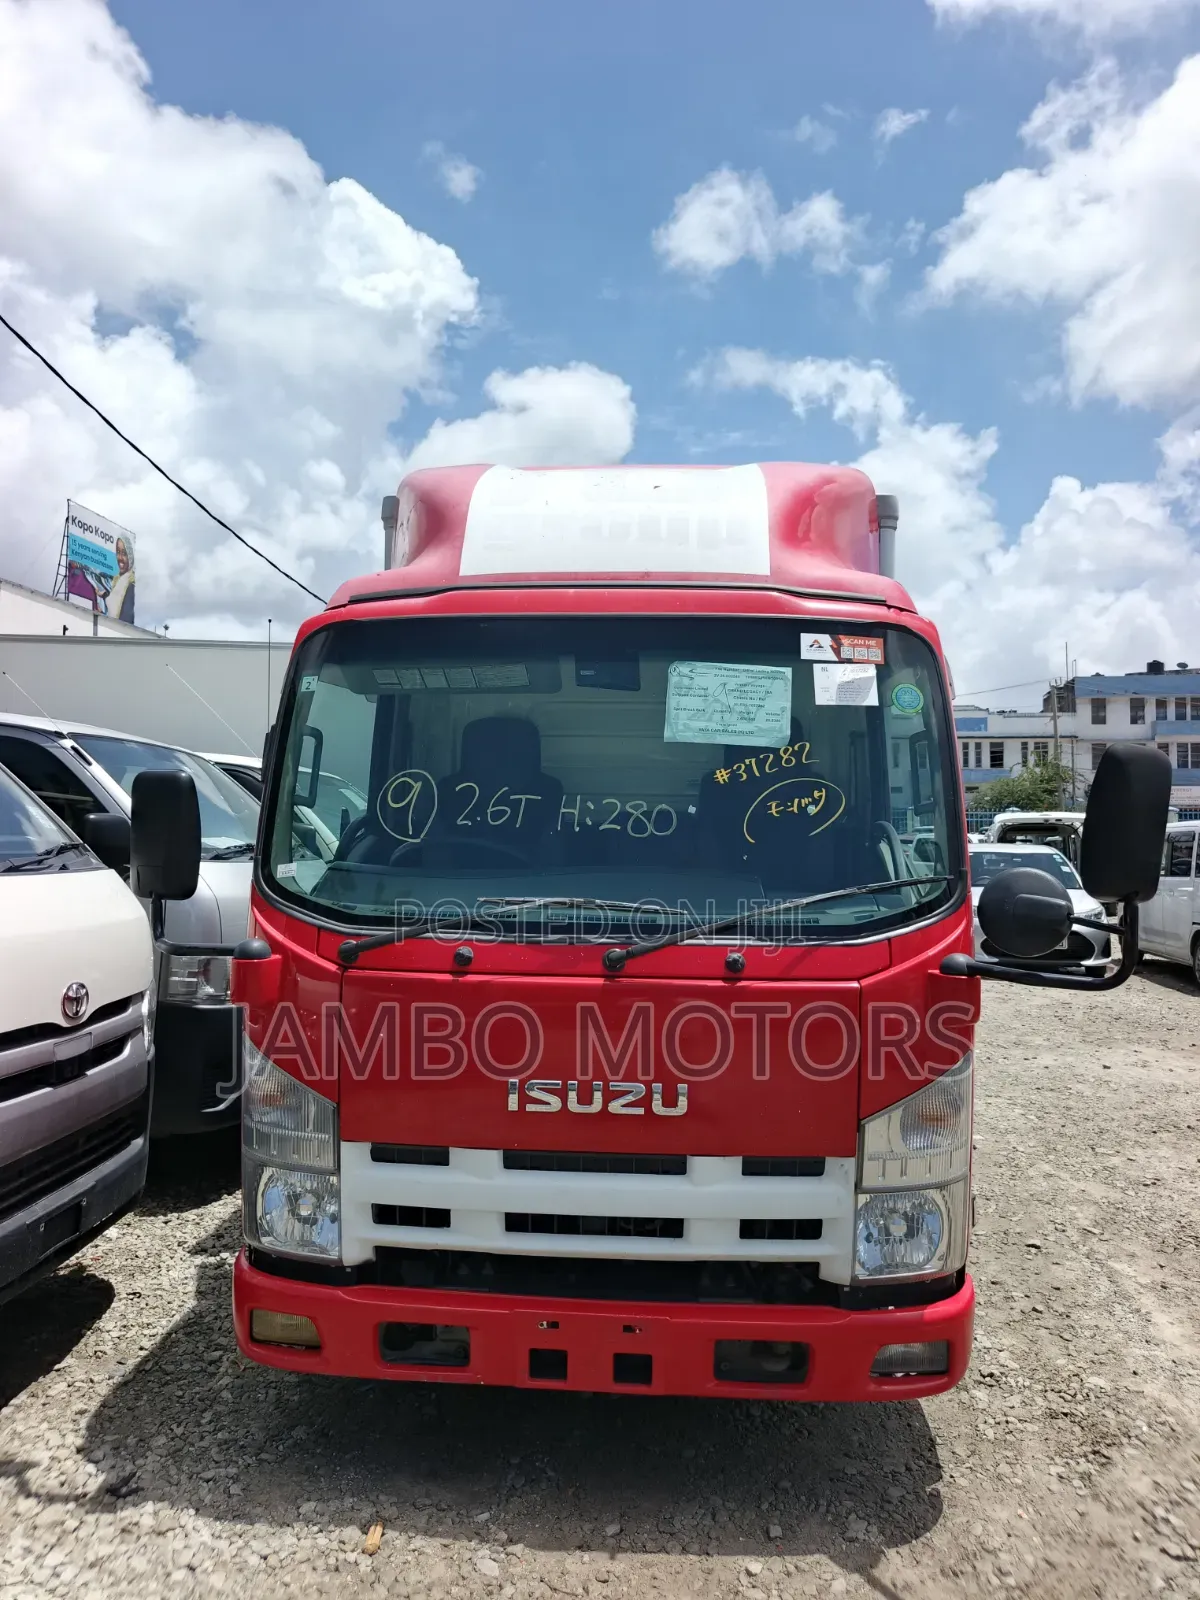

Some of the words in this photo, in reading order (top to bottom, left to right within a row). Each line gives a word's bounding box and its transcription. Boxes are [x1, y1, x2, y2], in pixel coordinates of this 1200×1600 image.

[71, 514, 94, 534] Kopo
[94, 525, 115, 544] Kopo
[71, 538, 77, 547] 15
[77, 542, 91, 553] years
[91, 548, 108, 561] serving
[71, 548, 90, 561] Kenyan
[90, 556, 114, 572] businesses
[305, 681, 312, 690] 2
[713, 742, 820, 784] #37282
[455, 782, 542, 828] 2.6T
[507, 1079, 688, 1116] ISUZU
